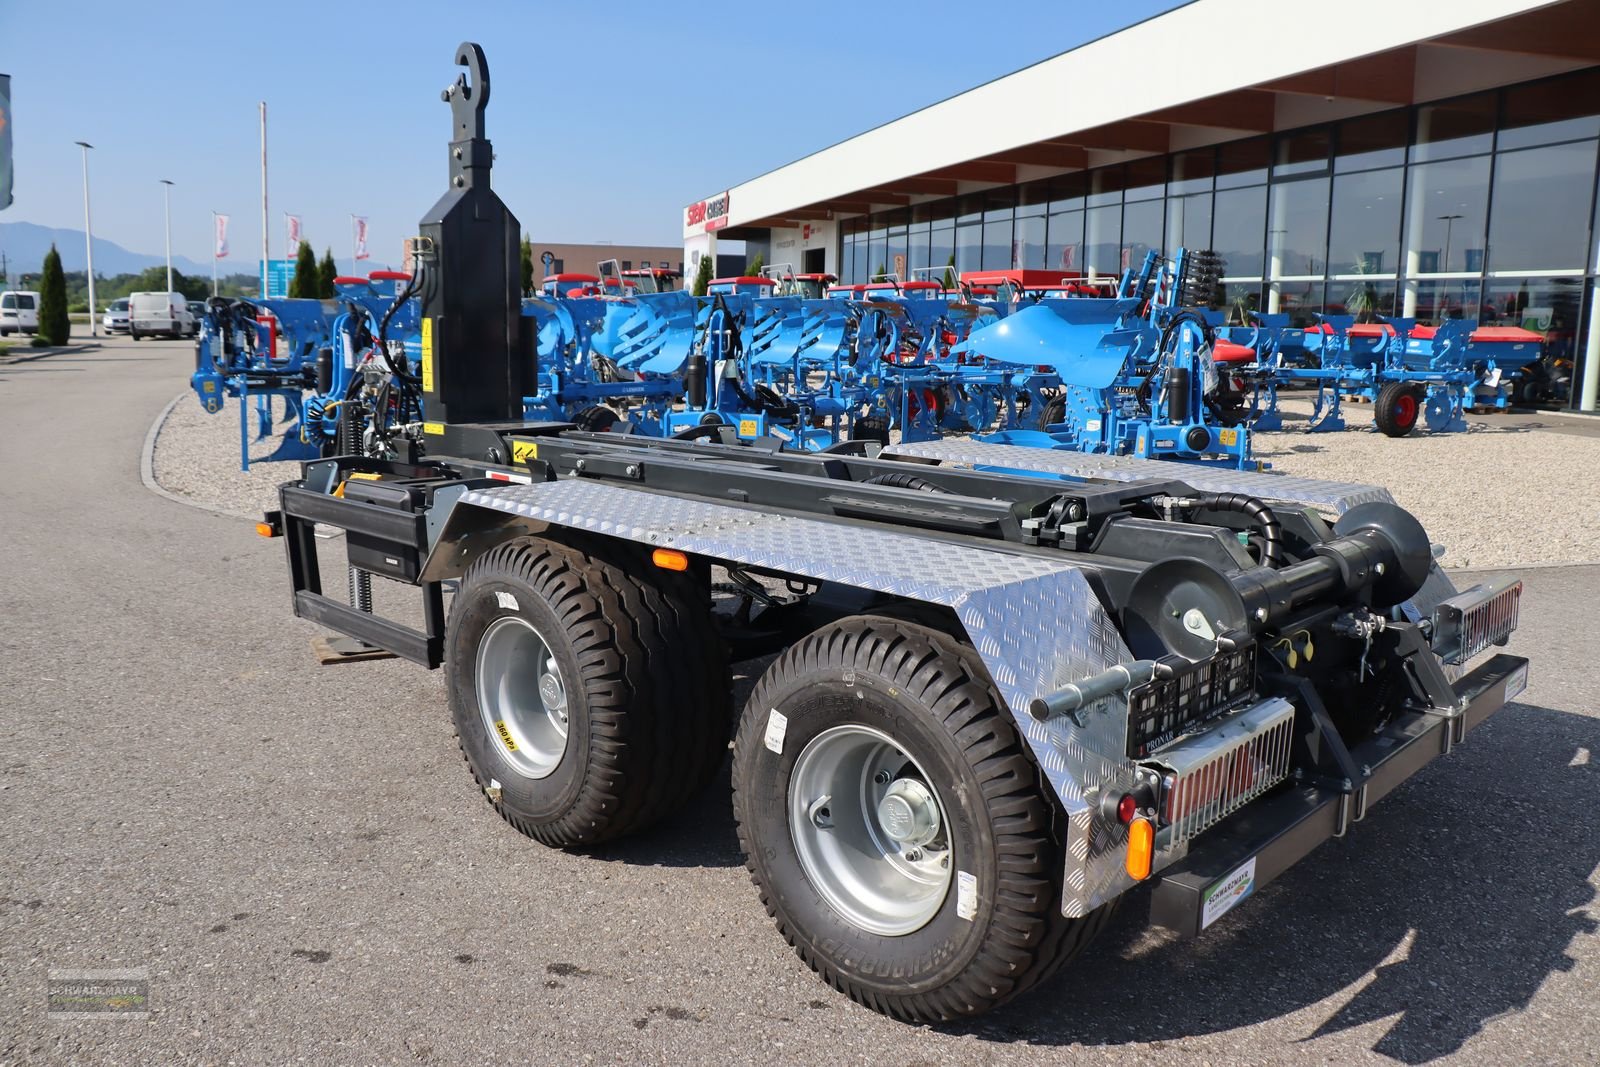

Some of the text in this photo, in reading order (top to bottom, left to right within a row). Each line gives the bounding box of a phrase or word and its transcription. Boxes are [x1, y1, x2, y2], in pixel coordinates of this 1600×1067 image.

[496, 723, 515, 750] 360 kPa
[1146, 731, 1174, 752] PRONAR
[1208, 870, 1249, 906] SCHWARZMAYR
